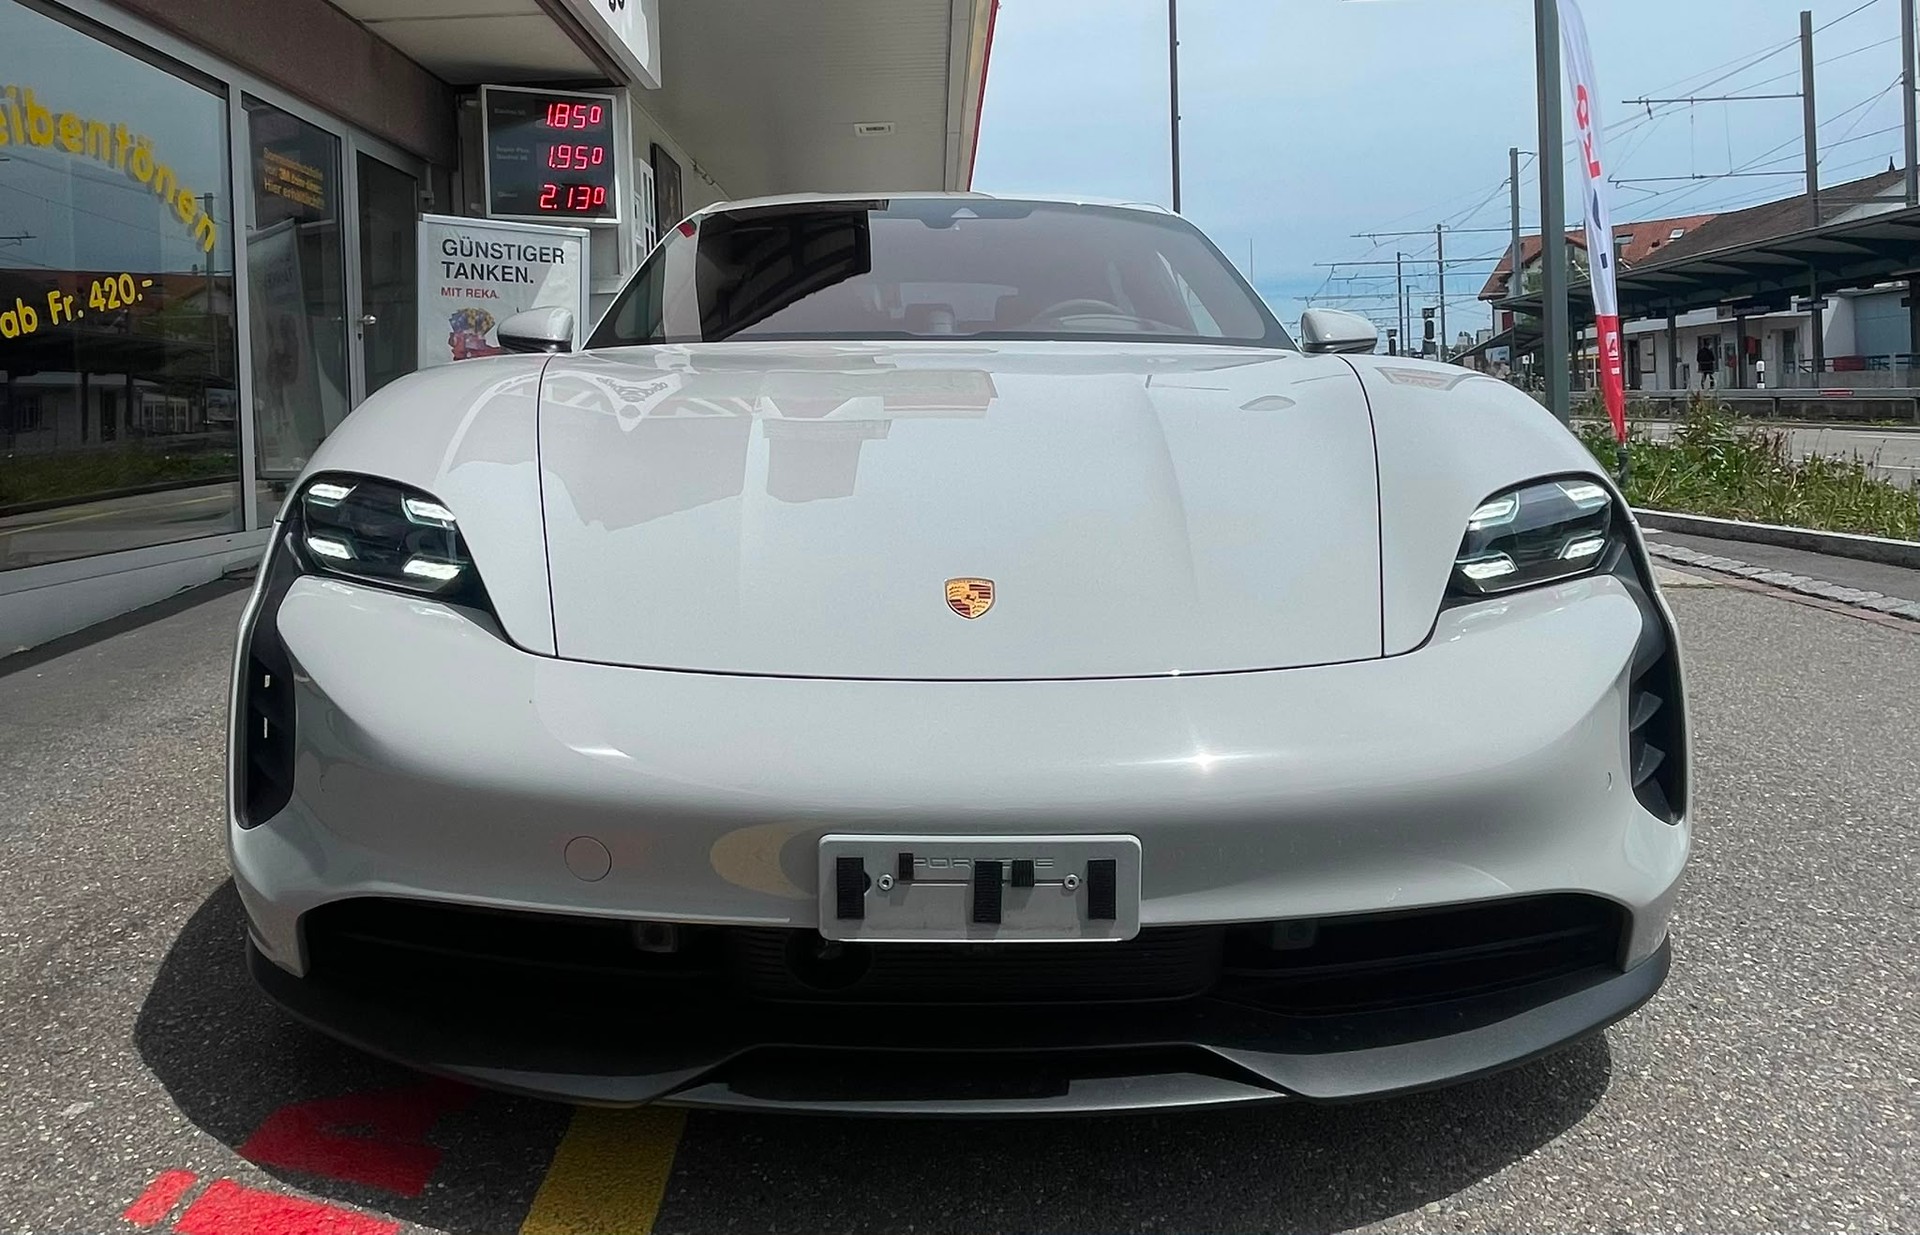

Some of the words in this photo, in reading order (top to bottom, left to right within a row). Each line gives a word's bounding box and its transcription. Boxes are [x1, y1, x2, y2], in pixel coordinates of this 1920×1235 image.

[546, 103, 602, 129] 1.850
[548, 144, 603, 170] 1.950
[540, 184, 605, 209] 2.130
[441, 235, 566, 264] GÜNSTIGER
[440, 261, 534, 284] TANKEN.
[440, 287, 462, 298] MIT
[465, 288, 500, 299] REKA.
[0, 297, 38, 340] ab
[47, 290, 84, 325] Fr.
[89, 273, 153, 313] 420.-
